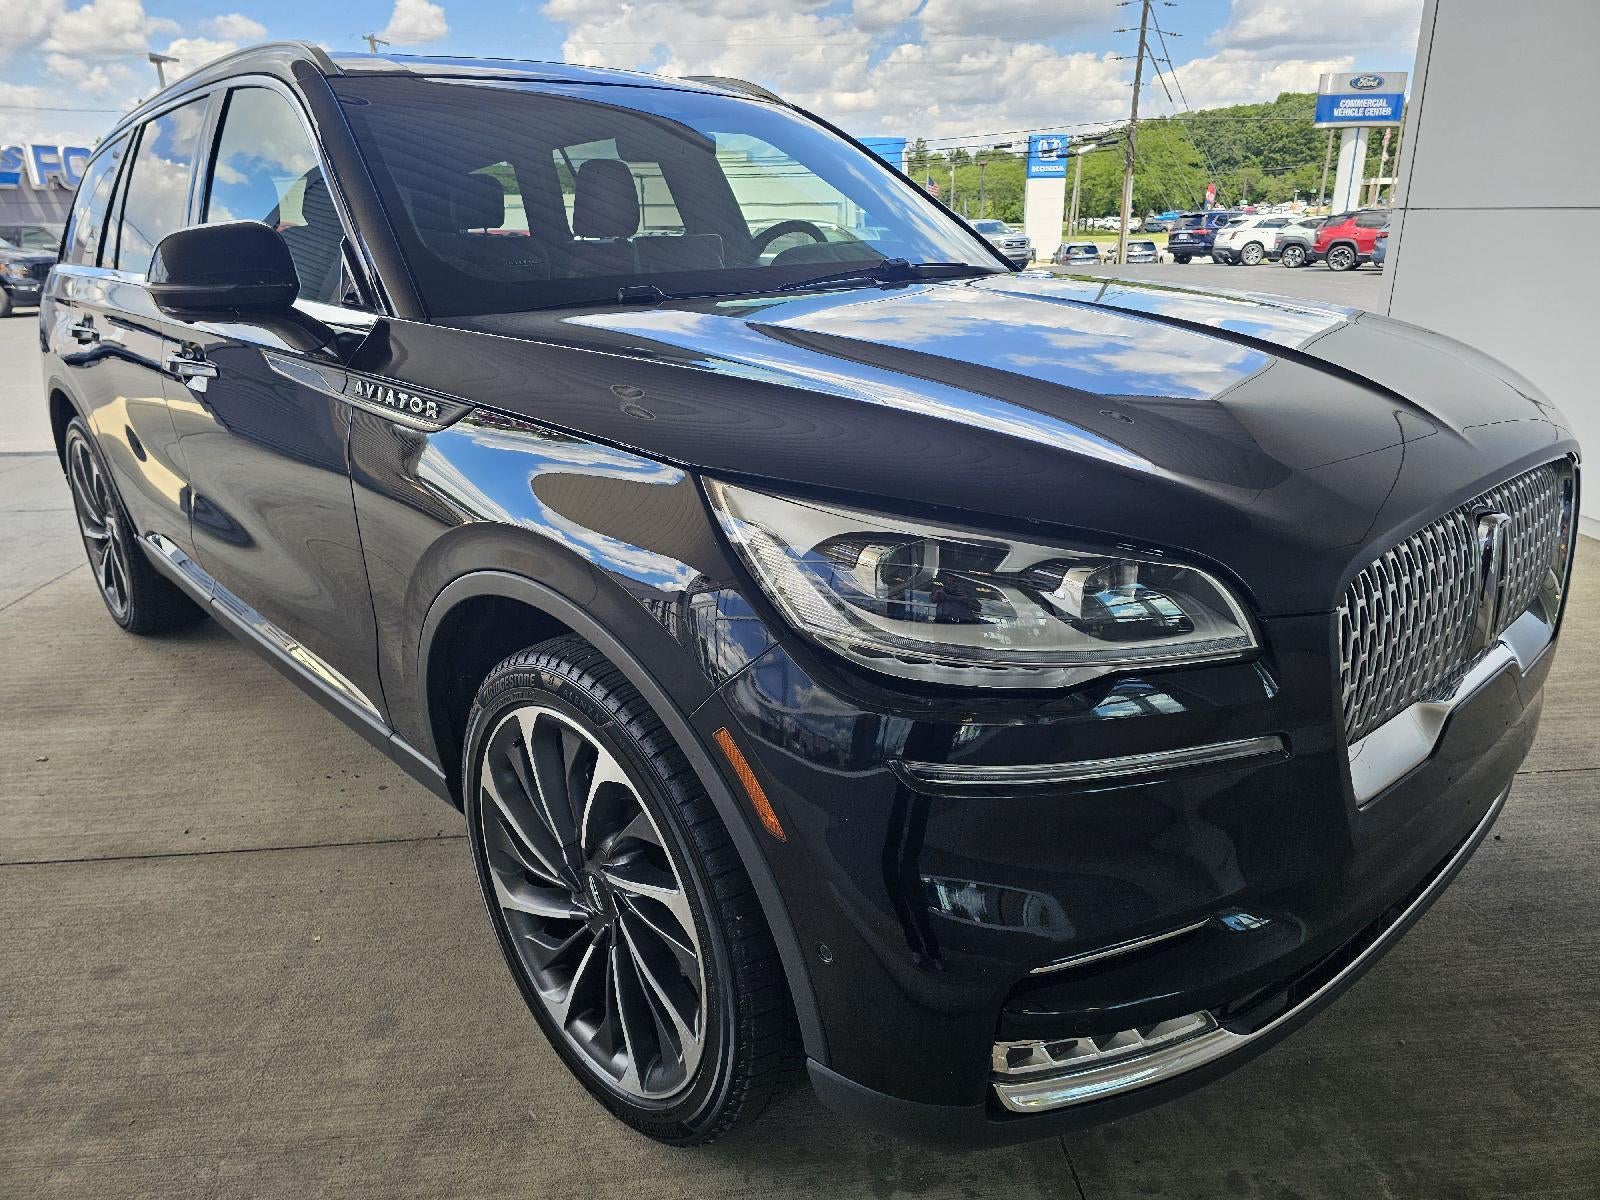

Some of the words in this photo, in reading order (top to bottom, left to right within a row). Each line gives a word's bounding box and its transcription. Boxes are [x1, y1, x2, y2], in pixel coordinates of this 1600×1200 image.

[1340, 98, 1388, 108] COMMERCIAL
[1333, 107, 1364, 117] VEHICLE
[1364, 107, 1392, 116] CENTER
[354, 380, 439, 419] AVIATOR
